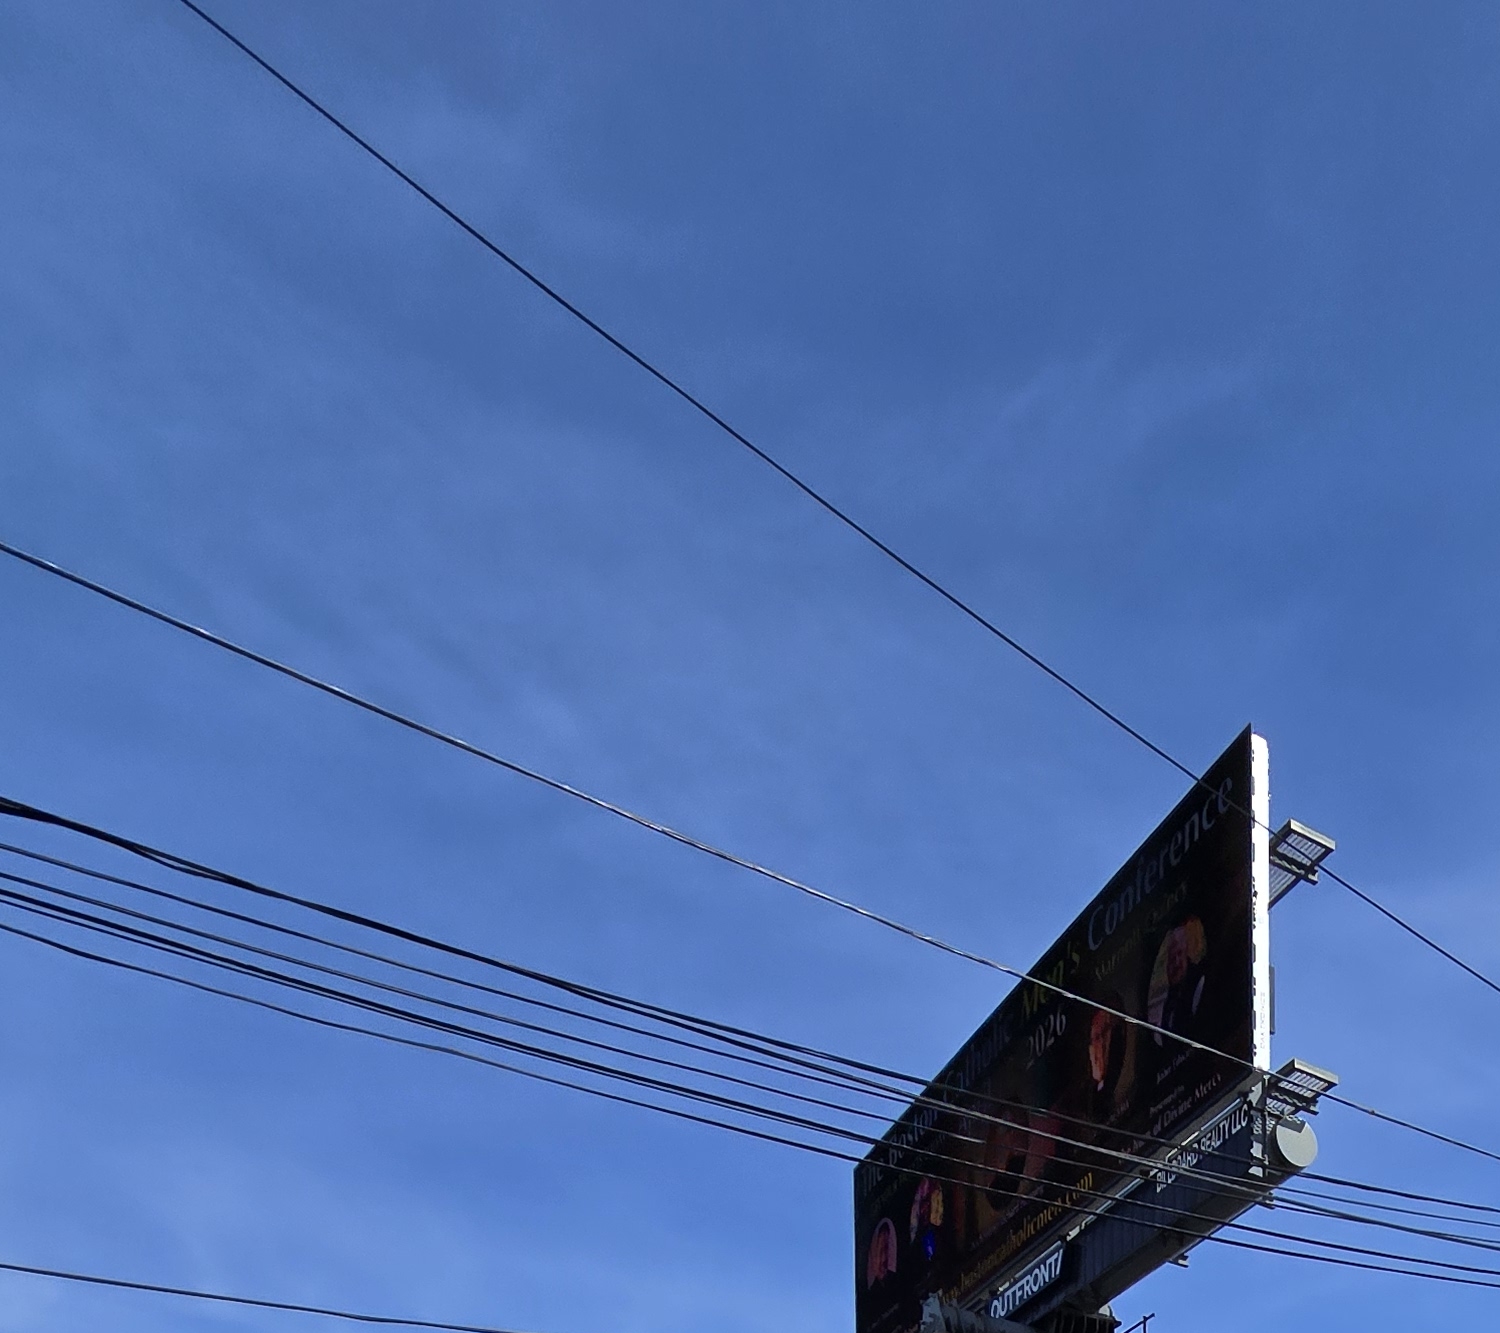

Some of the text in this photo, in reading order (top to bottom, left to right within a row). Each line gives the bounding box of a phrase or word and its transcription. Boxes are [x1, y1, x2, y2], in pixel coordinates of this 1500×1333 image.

[1021, 938, 1081, 1018] Men's
[1086, 775, 1234, 953] Conference
[1025, 1007, 1067, 1070] 2026
[1229, 1103, 1250, 1136] LLC
